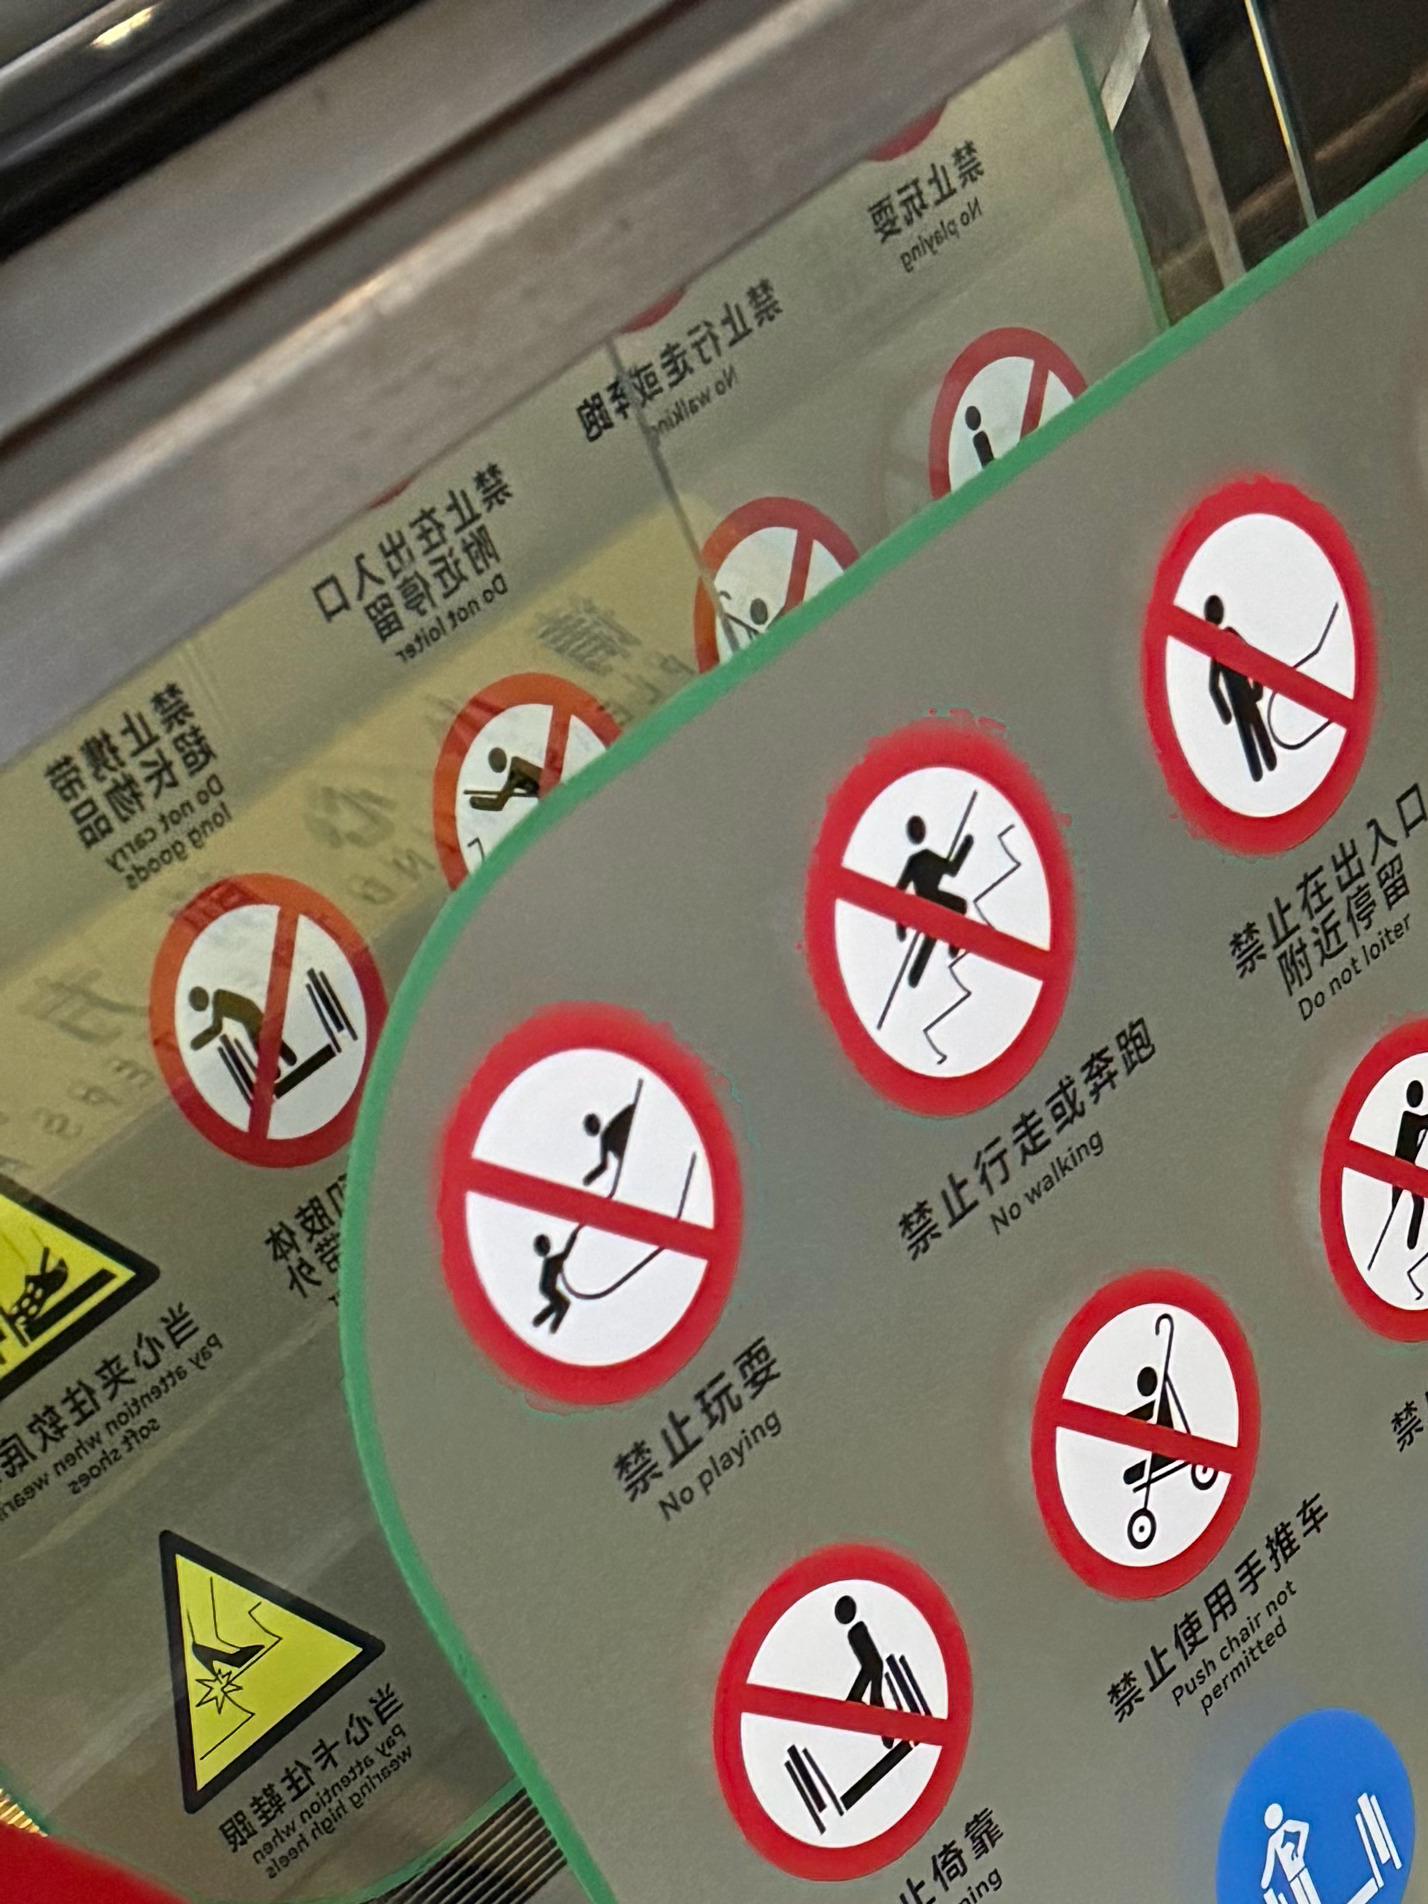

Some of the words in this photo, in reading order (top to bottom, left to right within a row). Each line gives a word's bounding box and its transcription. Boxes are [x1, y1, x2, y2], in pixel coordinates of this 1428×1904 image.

[1229, 782, 1428, 979] 禁止在出入口
[1276, 853, 1410, 996] 附近停留
[1298, 991, 1326, 1021] Do
[1329, 957, 1362, 995] not
[1362, 913, 1410, 966] loiter
[898, 1016, 1157, 1261] 禁止行走或奔跑
[990, 1202, 1023, 1235] No
[1024, 1130, 1105, 1205] walking
[614, 1335, 781, 1503] 禁止玩耍
[658, 1486, 695, 1521] No
[697, 1411, 782, 1495] playing
[1107, 1493, 1329, 1723] 禁止使用手推车
[1171, 1658, 1217, 1706] Push
[1219, 1612, 1261, 1662] chair
[1265, 1580, 1297, 1618] not
[1200, 1616, 1288, 1716] permitted
